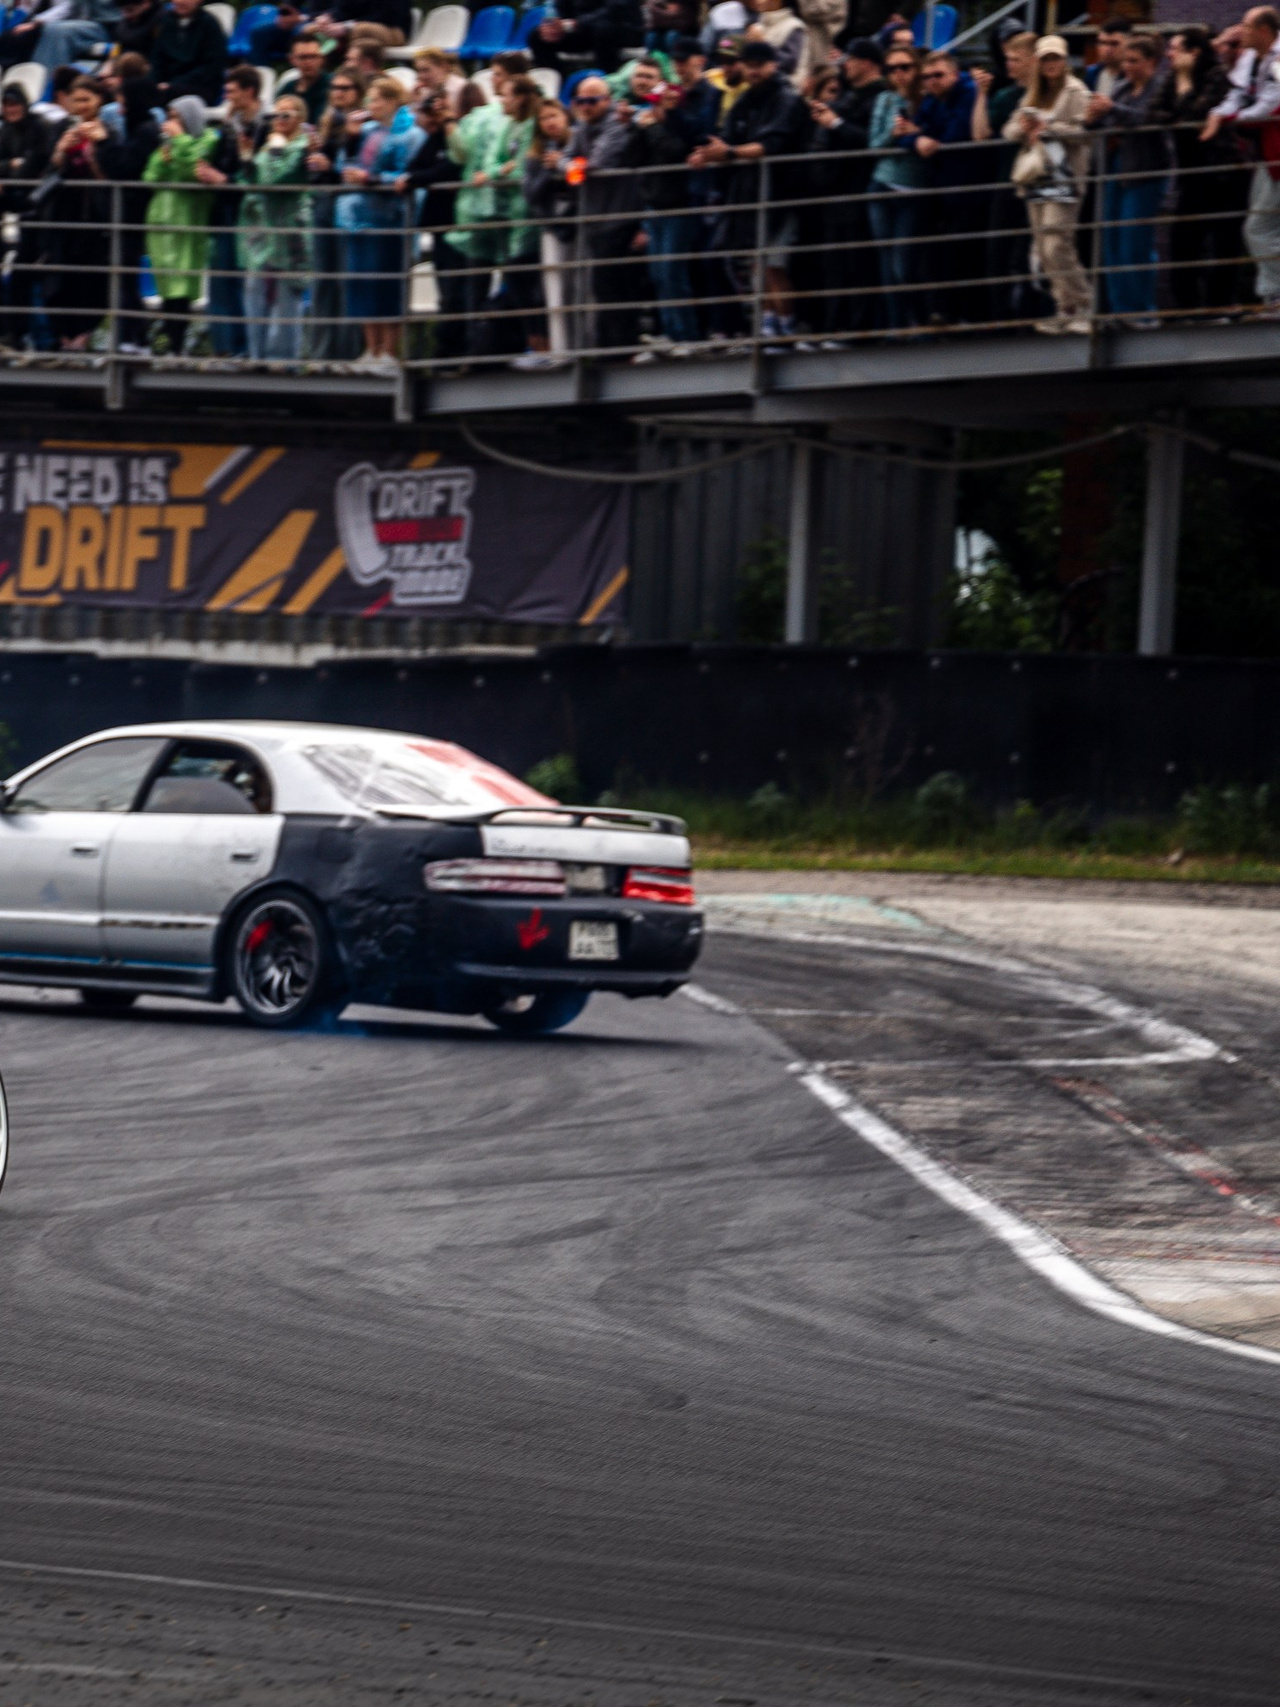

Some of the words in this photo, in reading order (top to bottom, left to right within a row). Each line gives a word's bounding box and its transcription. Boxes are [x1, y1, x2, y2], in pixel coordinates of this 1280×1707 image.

[14, 453, 121, 515] NEED
[130, 456, 168, 506] IS
[378, 479, 468, 518] DRIFT
[19, 504, 207, 592] DRIFT
